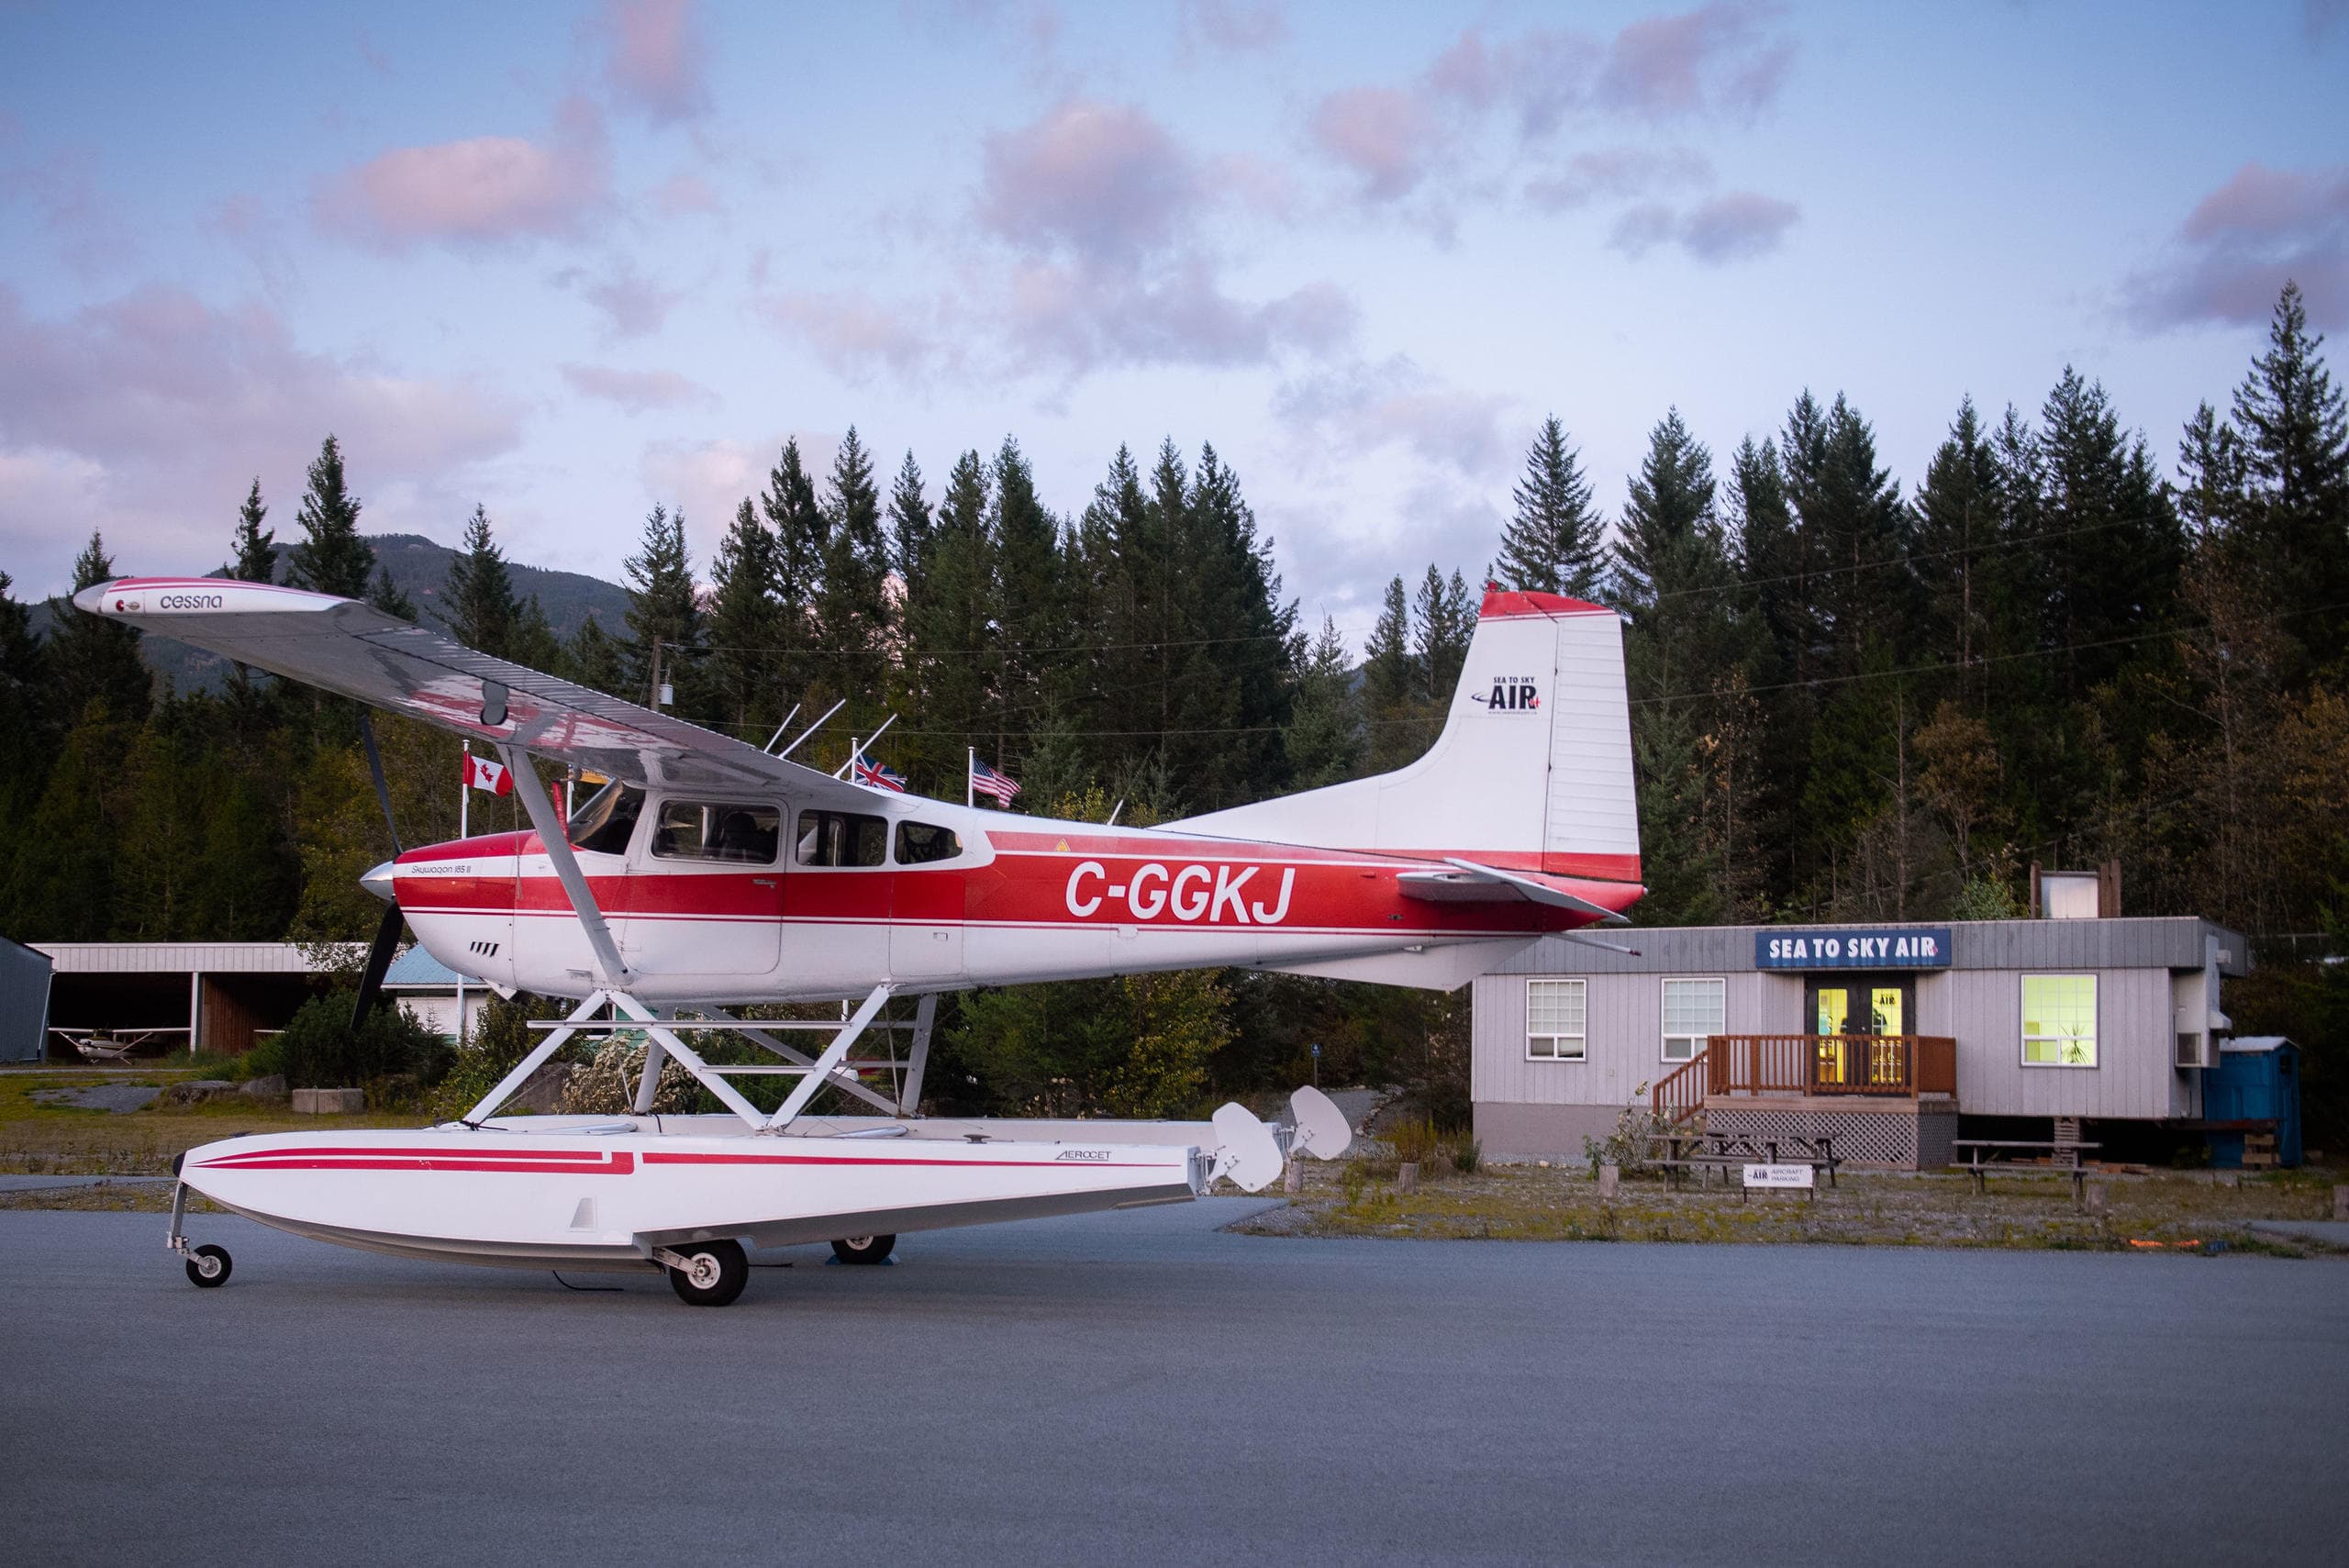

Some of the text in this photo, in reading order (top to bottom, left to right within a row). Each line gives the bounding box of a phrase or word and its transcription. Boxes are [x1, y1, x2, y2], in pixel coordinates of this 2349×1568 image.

[161, 595, 222, 608] cessna
[1488, 685, 1537, 709] AIR
[411, 865, 452, 874] Skywagon
[1065, 861, 1296, 924] C-GGKJ
[1769, 937, 1937, 959] SEA TO SKY AIR
[1753, 1171, 1767, 1180] AIR
